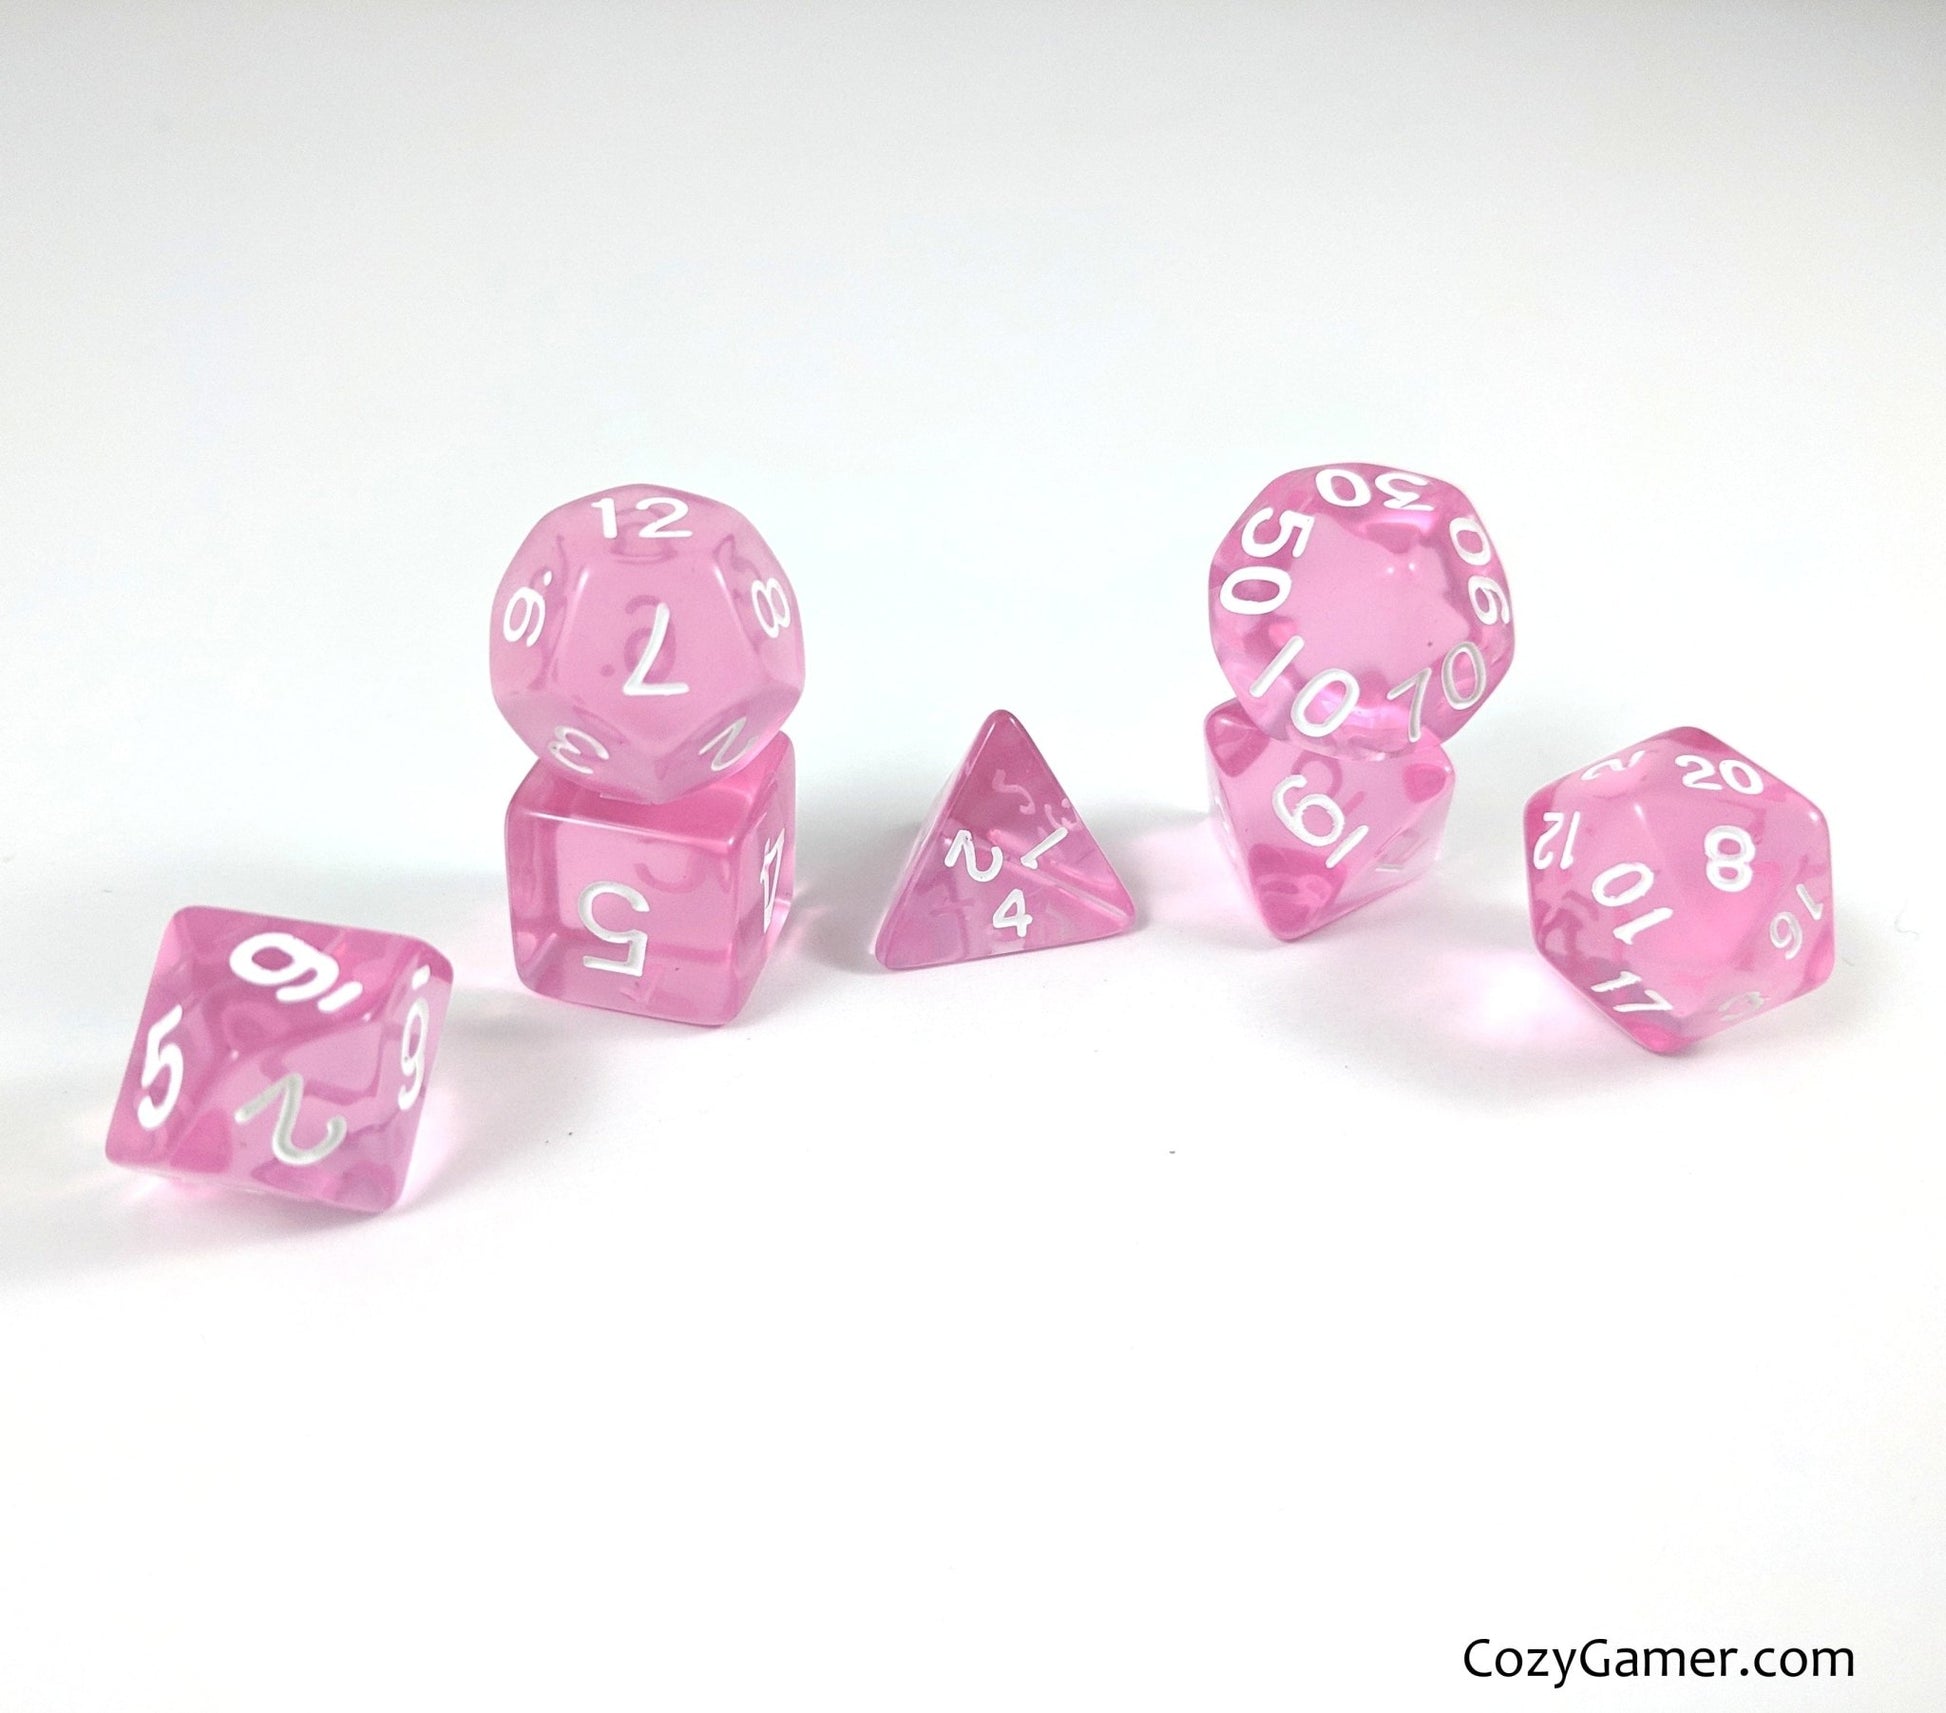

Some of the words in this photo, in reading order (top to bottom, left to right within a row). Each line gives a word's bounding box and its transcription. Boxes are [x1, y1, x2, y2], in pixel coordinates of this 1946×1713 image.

[590, 497, 694, 540] 12
[1314, 468, 1435, 512] 30
[1219, 506, 1315, 616] 50
[751, 577, 791, 639] 8
[622, 601, 690, 696] 7
[1249, 635, 1360, 738] 10
[1386, 641, 1487, 744] 70
[548, 725, 610, 775] 3
[699, 716, 760, 773] 2
[1674, 754, 1765, 795] 20
[943, 829, 1004, 883] 2
[1533, 810, 1582, 870] 12
[1704, 825, 1757, 893] 8
[577, 880, 651, 978] 5
[992, 888, 1034, 938] 4
[1591, 861, 1674, 946] 10
[1590, 970, 1674, 1014] 17
[136, 1003, 184, 1131] 5
[233, 1071, 348, 1166] 2
